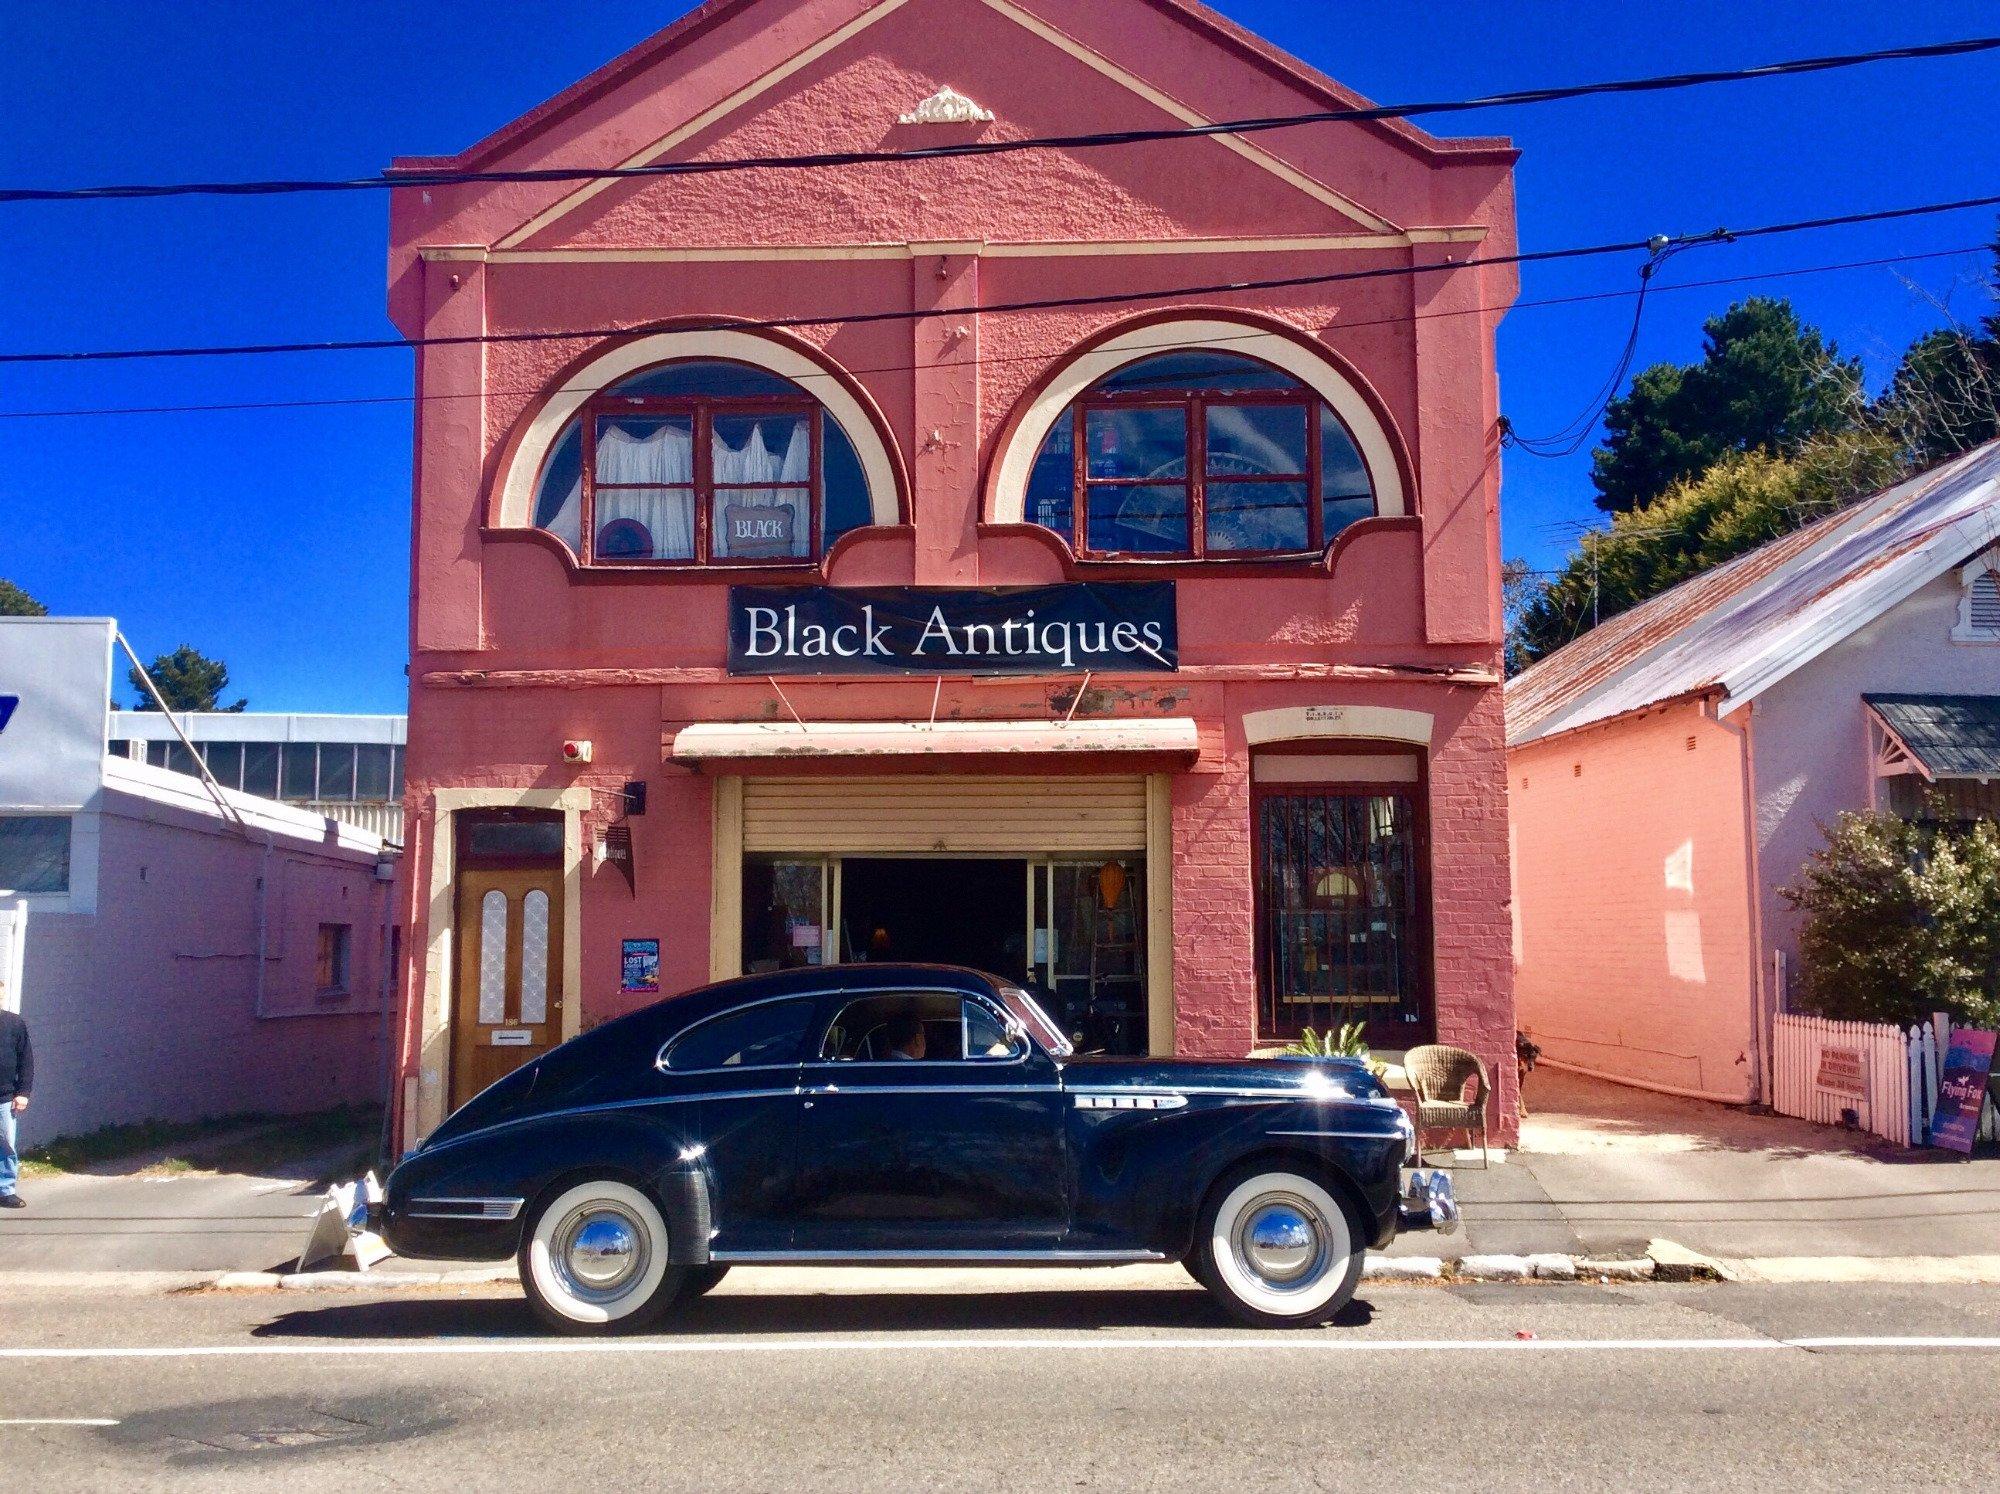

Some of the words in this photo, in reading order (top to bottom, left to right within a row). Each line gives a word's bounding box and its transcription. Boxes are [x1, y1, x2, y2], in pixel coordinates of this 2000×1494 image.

[734, 519, 784, 539] BLACK
[744, 605, 894, 658] Black
[911, 604, 1163, 667] Antiques
[624, 956, 642, 965] LOST
[1941, 1081, 1967, 1100] Flying
[1967, 1085, 1983, 1100] Fox
